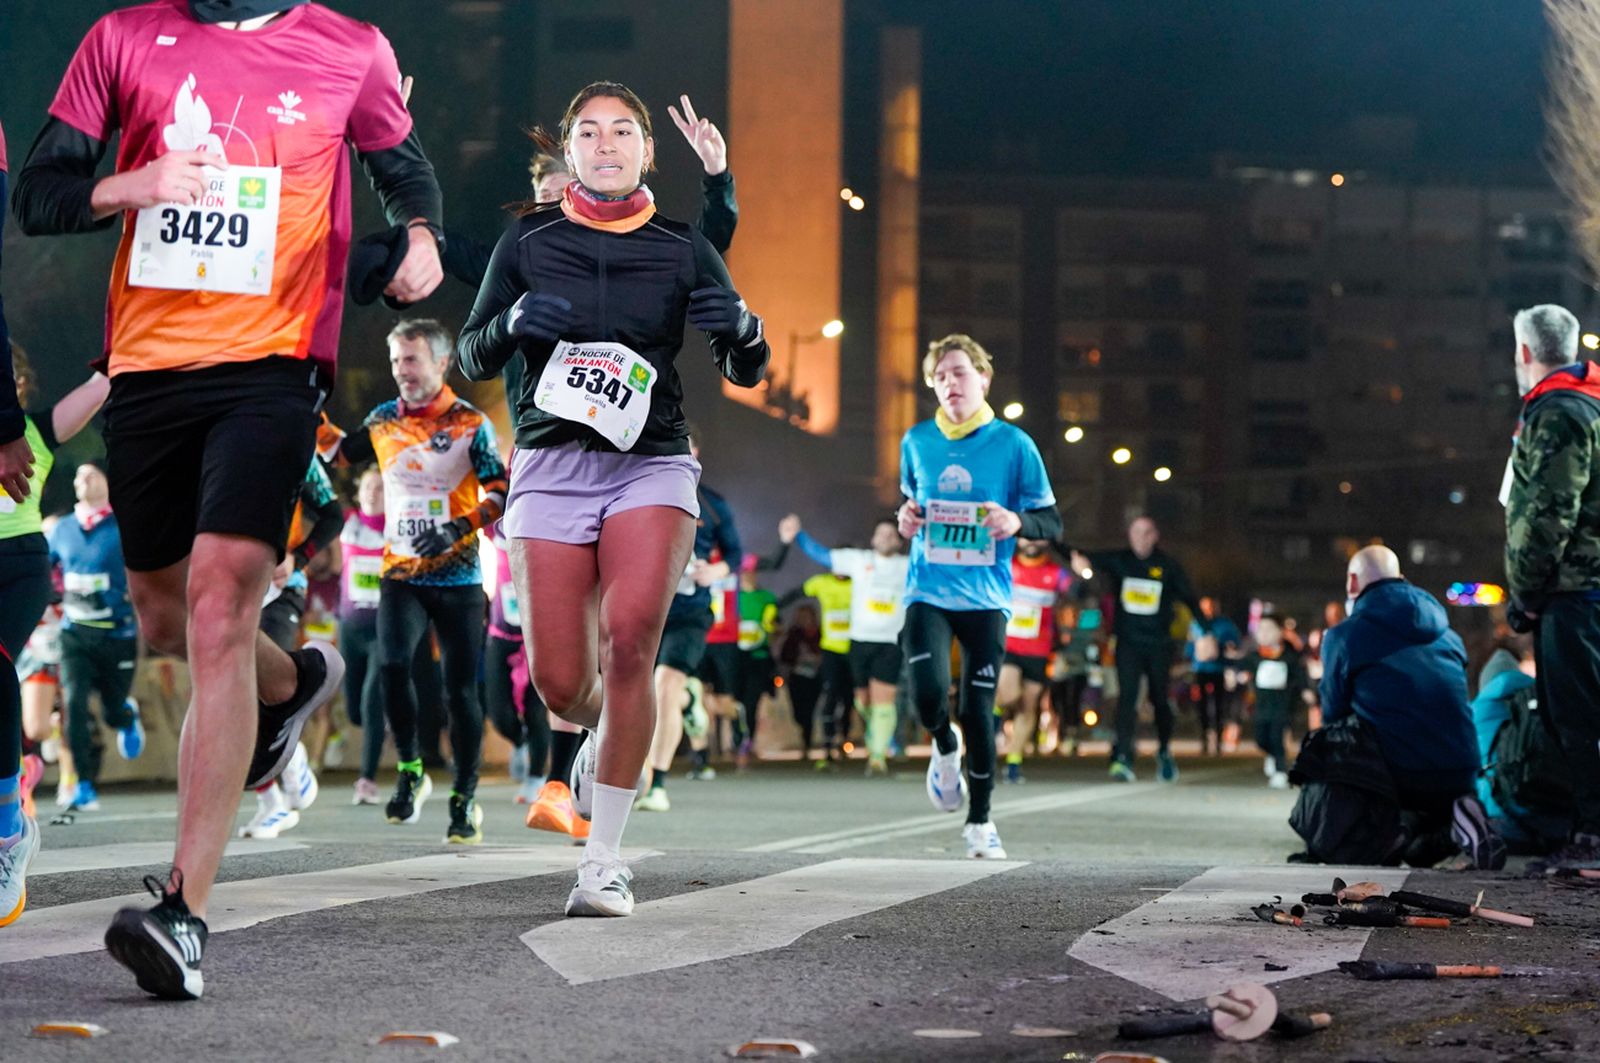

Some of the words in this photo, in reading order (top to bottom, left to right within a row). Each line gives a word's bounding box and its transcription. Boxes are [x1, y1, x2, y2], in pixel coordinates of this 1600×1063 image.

[160, 207, 249, 248] 3429
[190, 248, 214, 259] Pablo
[564, 357, 586, 365] SAN
[613, 353, 625, 366] DE
[567, 366, 633, 411] 5347
[943, 524, 977, 544] 7771
